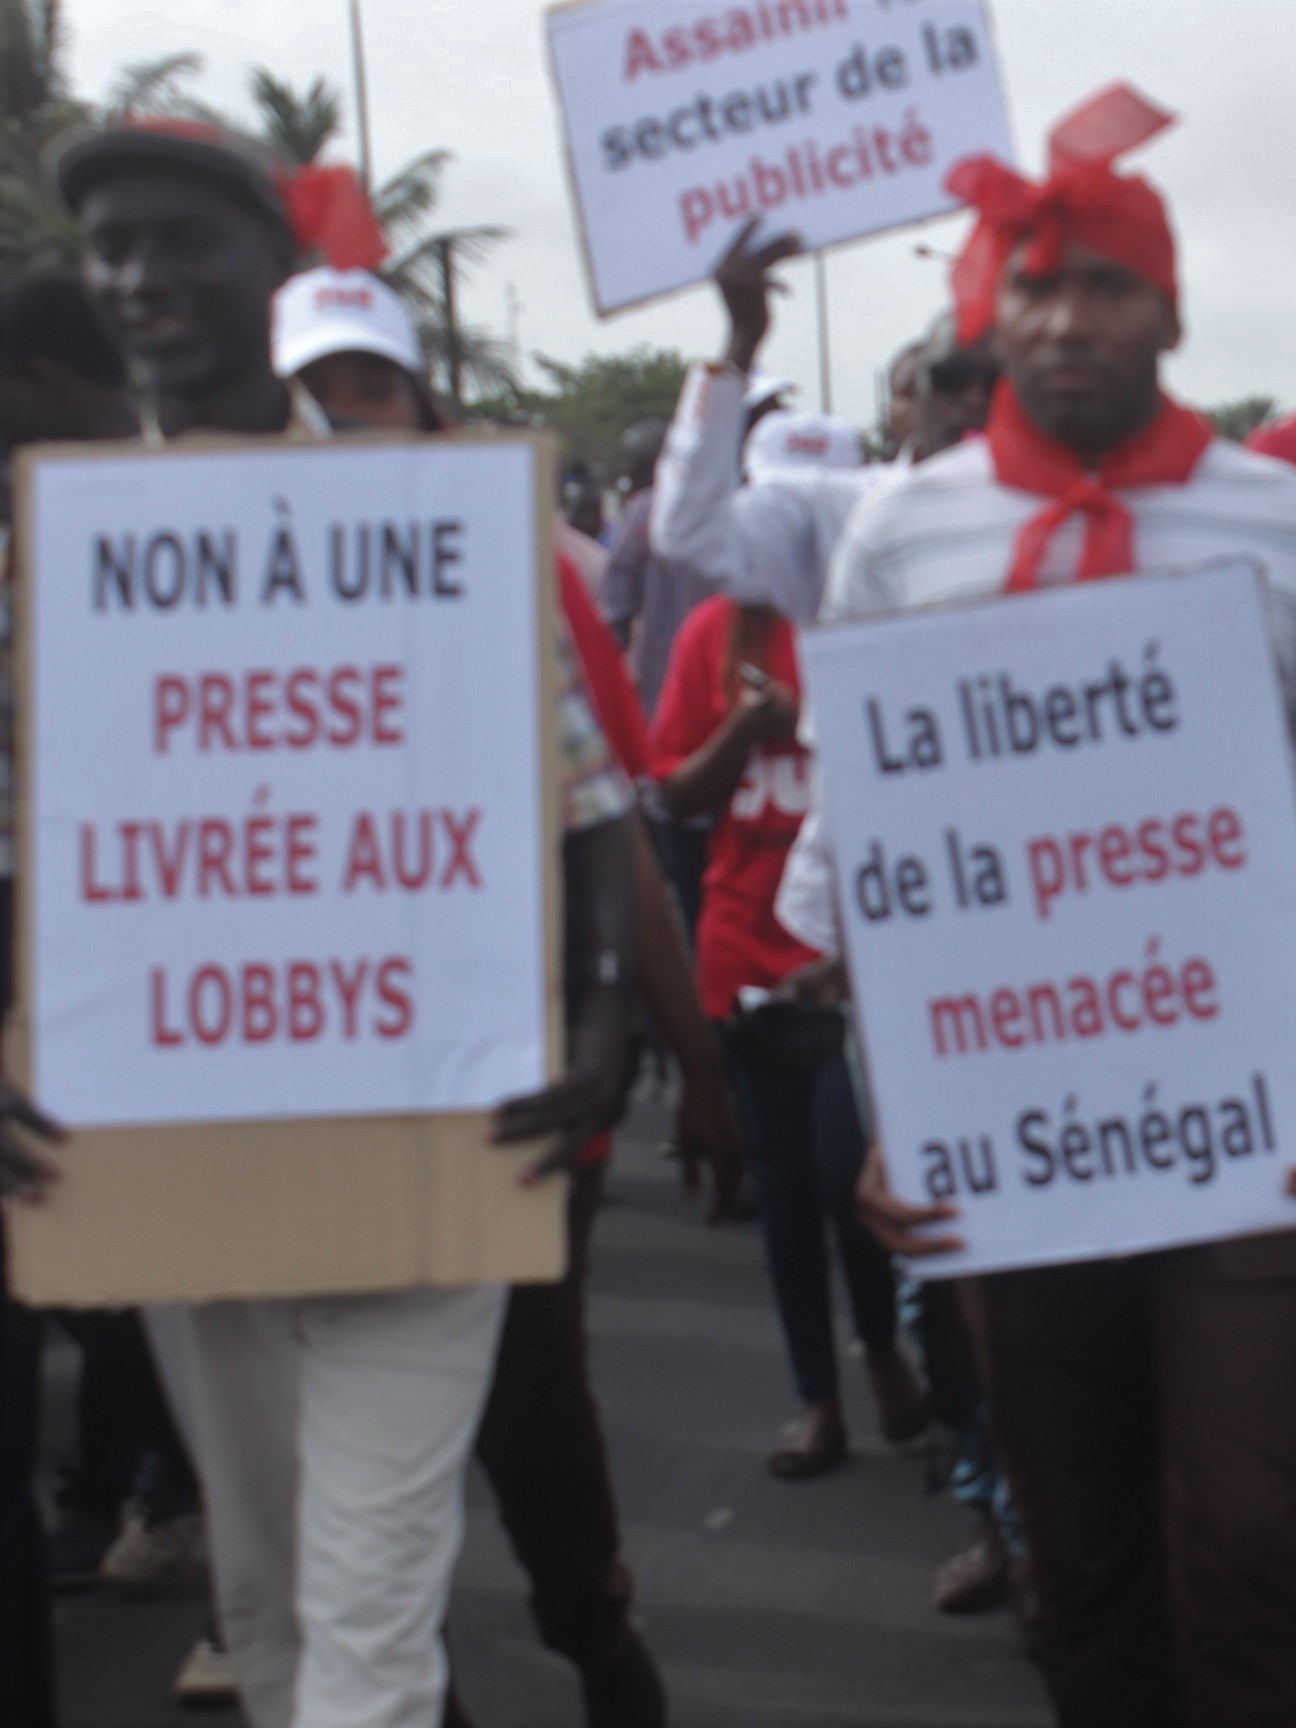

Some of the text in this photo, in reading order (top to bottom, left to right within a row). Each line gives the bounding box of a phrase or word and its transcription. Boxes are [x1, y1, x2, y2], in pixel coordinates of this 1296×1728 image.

[600, 24, 979, 171] secteur de la
[679, 108, 933, 243] publicité
[94, 501, 463, 612] NON À UNE
[154, 665, 404, 753] PRESSE
[866, 644, 1179, 777] La liberté
[80, 788, 481, 904] LIVRÉE AUX
[854, 807, 1246, 924] de la presse
[151, 956, 414, 1048] LOBBYS
[928, 938, 1220, 1056] menacée
[922, 1074, 1275, 1204] au Sénégal
